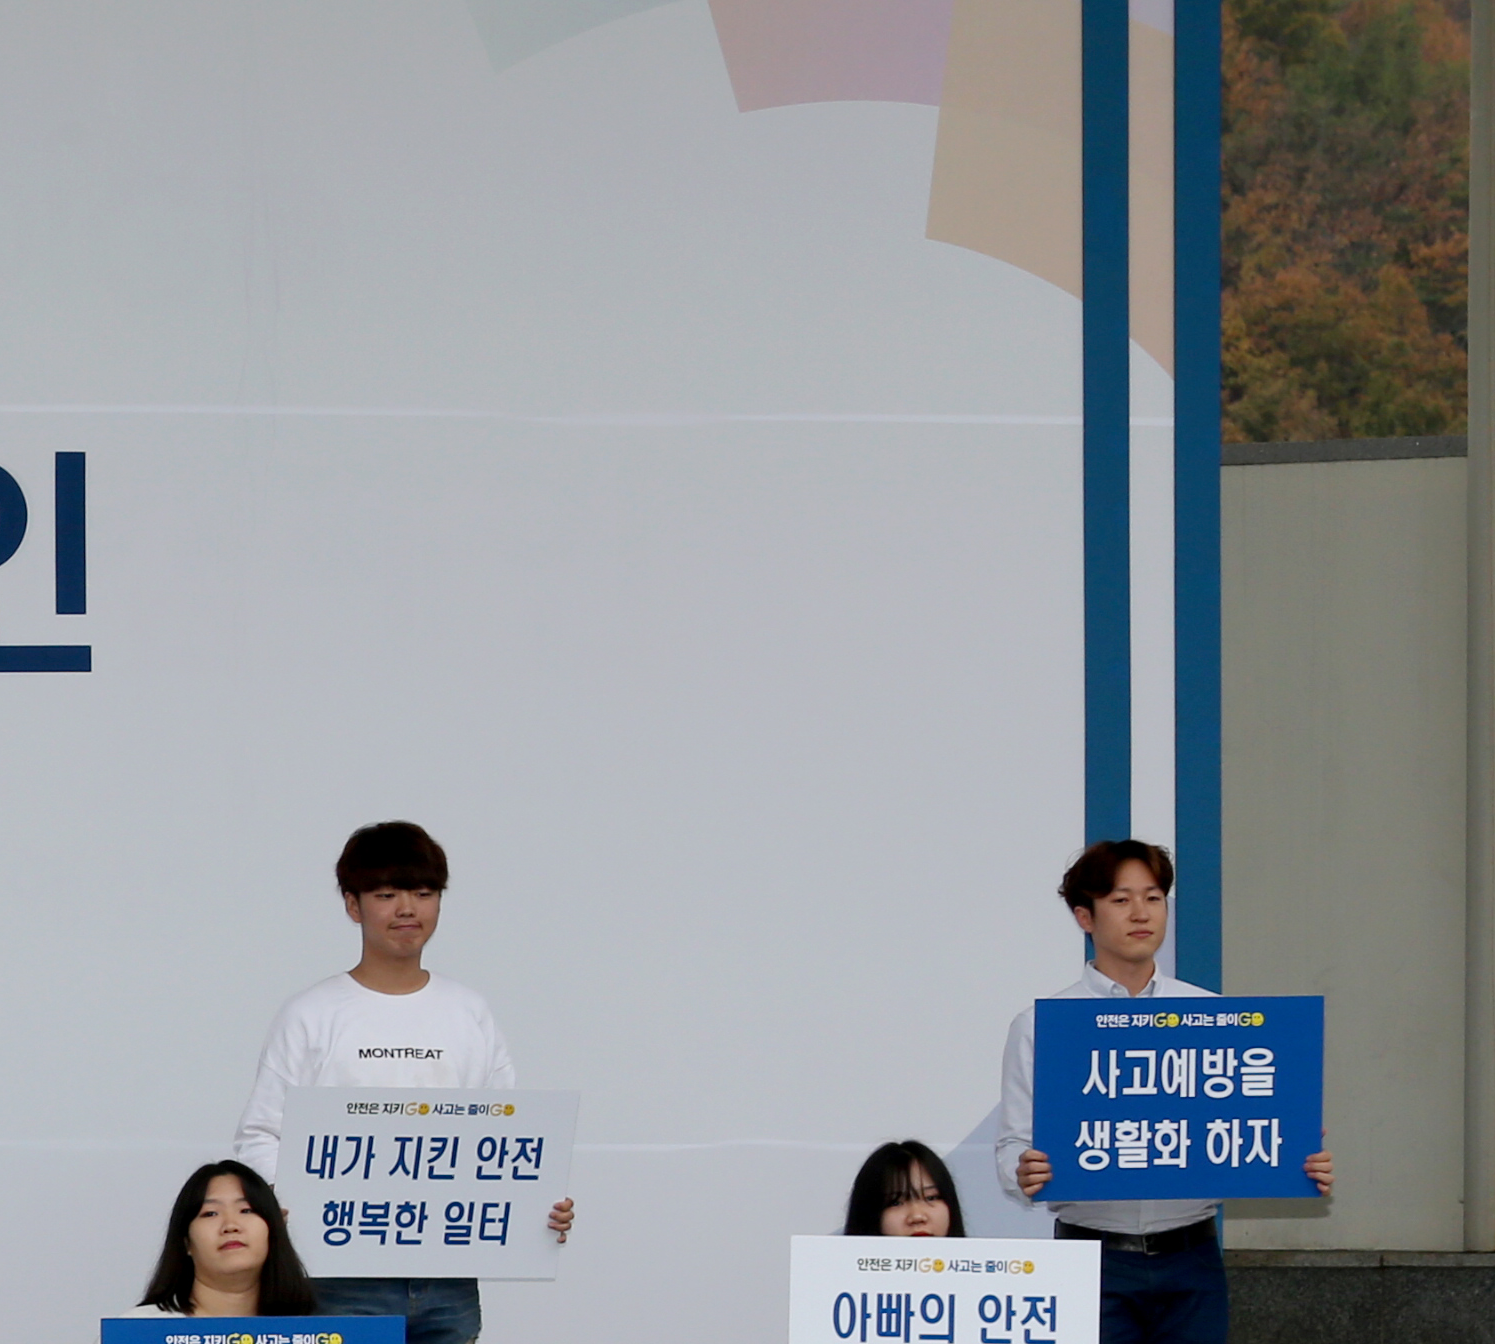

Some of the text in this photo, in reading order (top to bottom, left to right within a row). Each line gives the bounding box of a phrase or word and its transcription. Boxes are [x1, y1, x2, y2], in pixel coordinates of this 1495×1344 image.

[1096, 1014, 1130, 1028] 안전은
[1180, 1013, 1215, 1028] 사고는
[359, 1048, 443, 1060] MONTREAT
[1082, 1048, 1275, 1098] 사고예방을
[347, 1102, 379, 1115] 안전은
[432, 1103, 465, 1115] 사고는
[306, 1135, 544, 1180] 내가 지킨 안전
[1075, 1118, 1282, 1170] 생활화 하자
[323, 1200, 511, 1246] 행복한 일터
[857, 1258, 892, 1271] 안전은
[947, 1260, 982, 1273] 사고는
[833, 1292, 1057, 1344] 아빠의 안전
